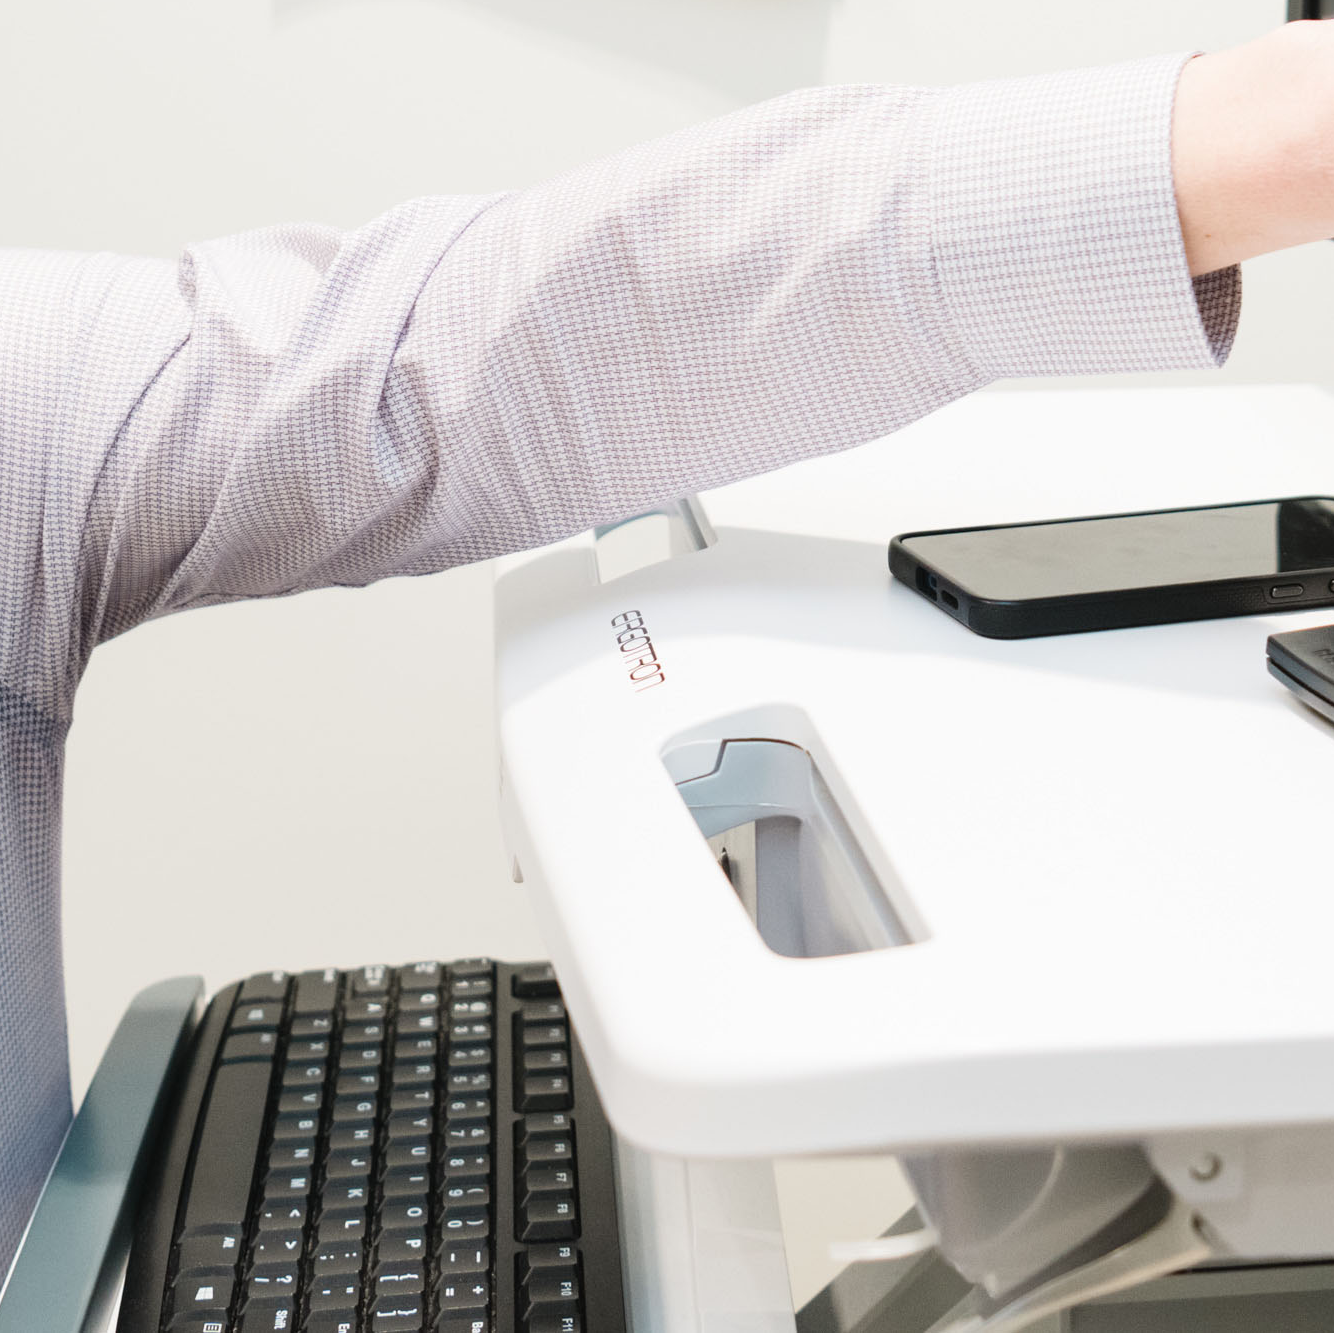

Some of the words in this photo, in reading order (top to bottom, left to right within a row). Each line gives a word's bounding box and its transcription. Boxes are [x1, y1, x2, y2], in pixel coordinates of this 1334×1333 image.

[367, 1003, 382, 1012] A
[454, 1003, 469, 1011] 2
[314, 1019, 328, 1027] Z
[419, 1016, 433, 1027] W
[454, 1026, 468, 1034] 3
[310, 1042, 324, 1050] X
[417, 1040, 432, 1048] E
[362, 1050, 376, 1058] D
[306, 1067, 321, 1075] C
[416, 1065, 431, 1074] R
[303, 1093, 317, 1102] V
[415, 1091, 429, 1099] T
[357, 1102, 372, 1111] G
[451, 1102, 466, 1110] 6
[298, 1120, 314, 1128] B
[413, 1118, 428, 1126] Y
[354, 1130, 369, 1138] H
[451, 1129, 465, 1137] 7
[411, 1146, 426, 1155] U
[555, 1143, 565, 1153] F6
[294, 1148, 310, 1158] N
[351, 1158, 366, 1166] J
[450, 1158, 465, 1166] 8
[556, 1172, 567, 1182] F7
[290, 1178, 306, 1188] M
[347, 1188, 363, 1198] K
[448, 1189, 464, 1197] 9
[407, 1207, 422, 1217] O
[557, 1203, 568, 1214] F8
[345, 1220, 360, 1229] L
[222, 1237, 235, 1249] Alt
[406, 1239, 422, 1248] P
[559, 1247, 571, 1258] F9
[560, 1281, 572, 1296] F10
[274, 1309, 288, 1330] Shift
[562, 1317, 574, 1332] F11
